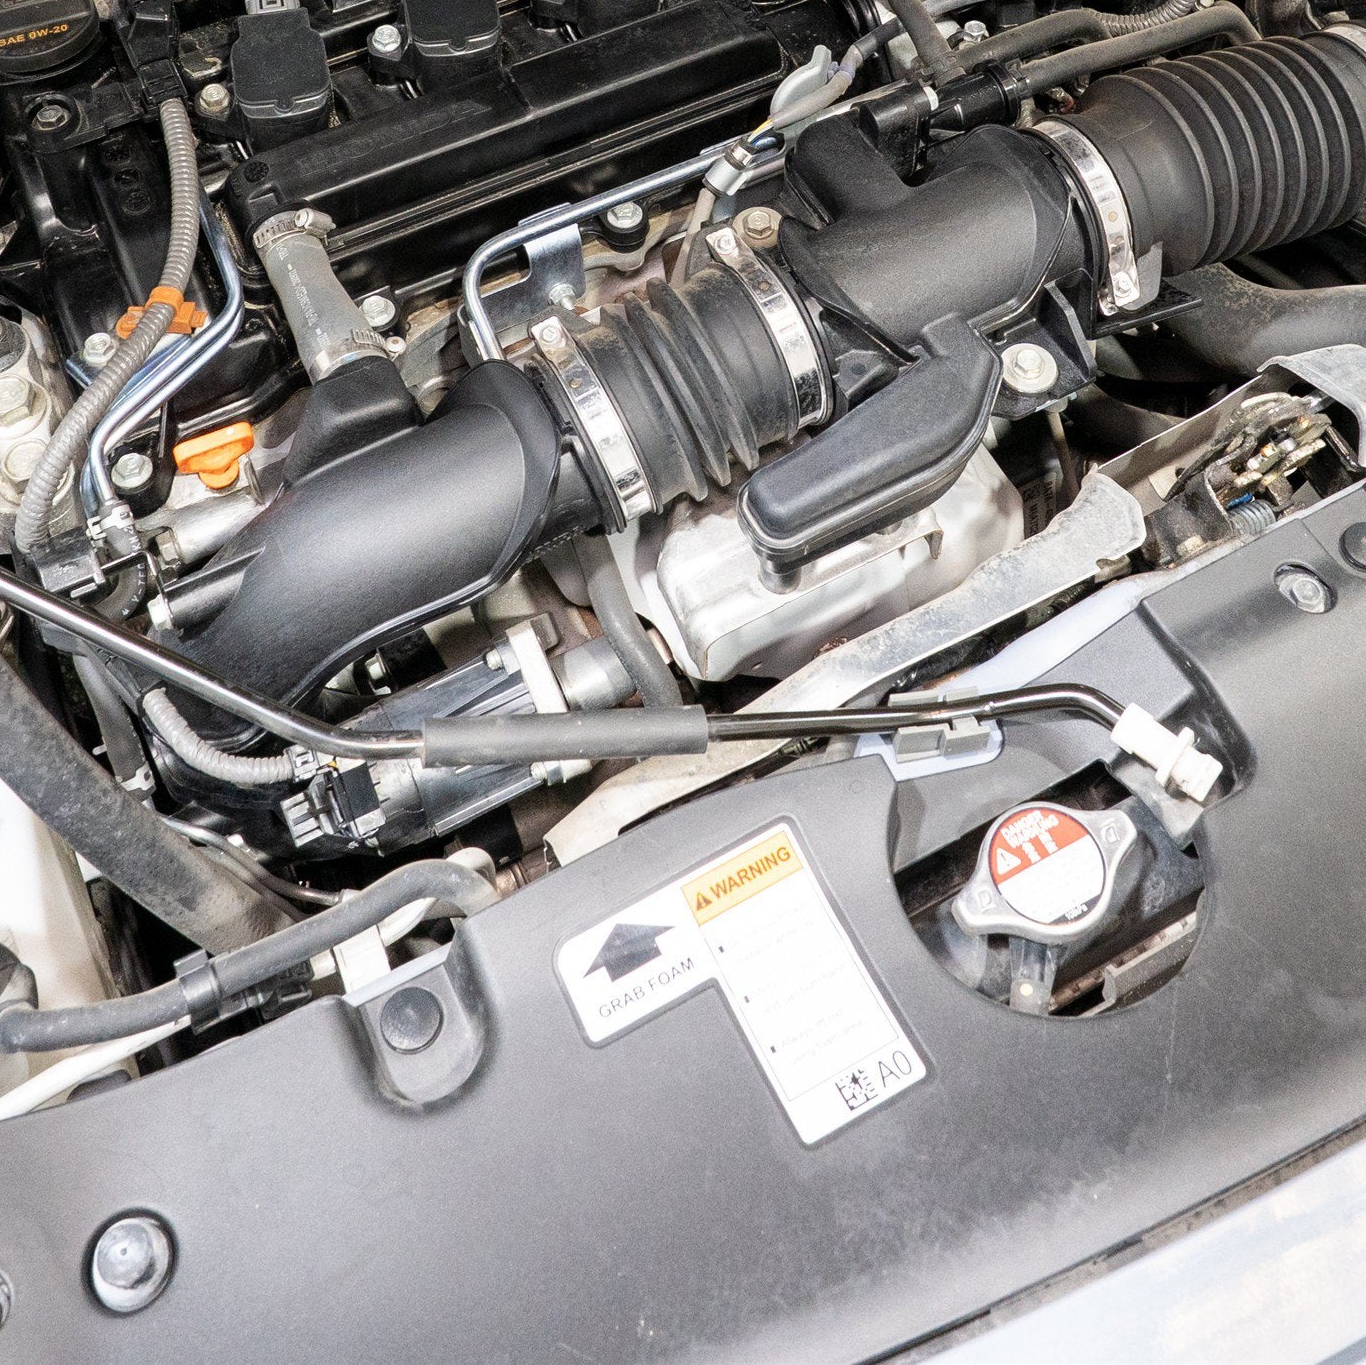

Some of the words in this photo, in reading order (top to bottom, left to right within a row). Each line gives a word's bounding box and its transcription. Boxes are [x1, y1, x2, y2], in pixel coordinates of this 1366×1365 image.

[28, 23, 69, 40] 0W-20
[709, 845, 792, 900] WARNING
[598, 984, 644, 1020] GRAB
[648, 957, 696, 992] FOAM
[878, 1049, 913, 1090] A0
